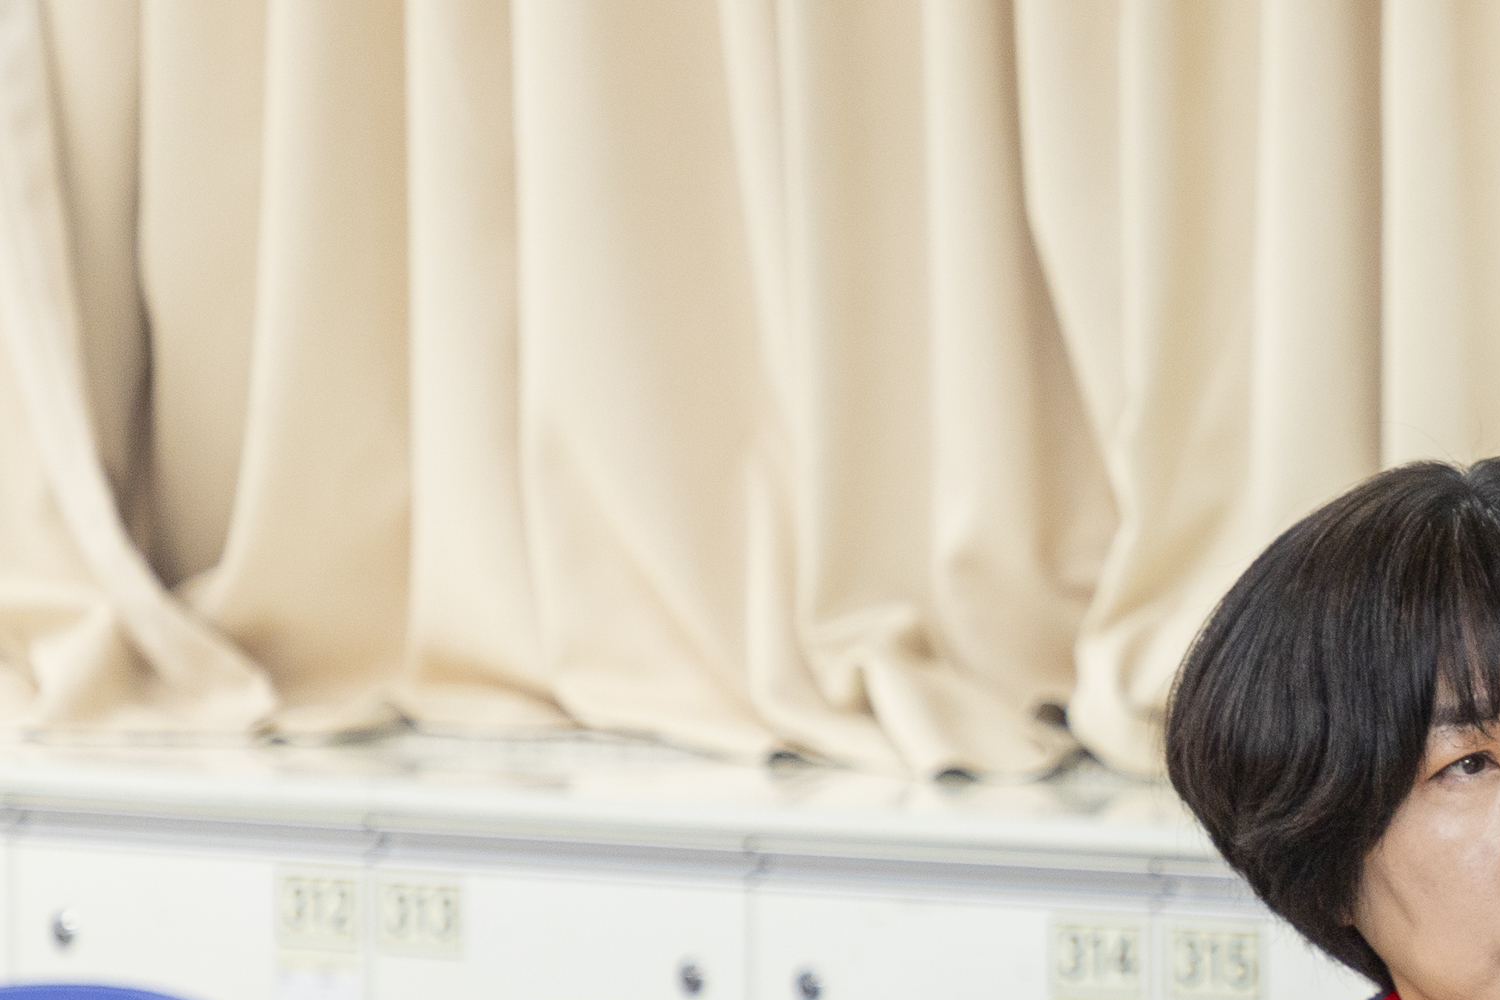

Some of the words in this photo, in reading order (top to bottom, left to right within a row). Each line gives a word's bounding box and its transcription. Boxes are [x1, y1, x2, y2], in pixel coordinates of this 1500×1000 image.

[282, 885, 354, 934] 312
[385, 892, 457, 943] 313
[1058, 933, 1138, 981] 314
[1173, 938, 1251, 990] 315
